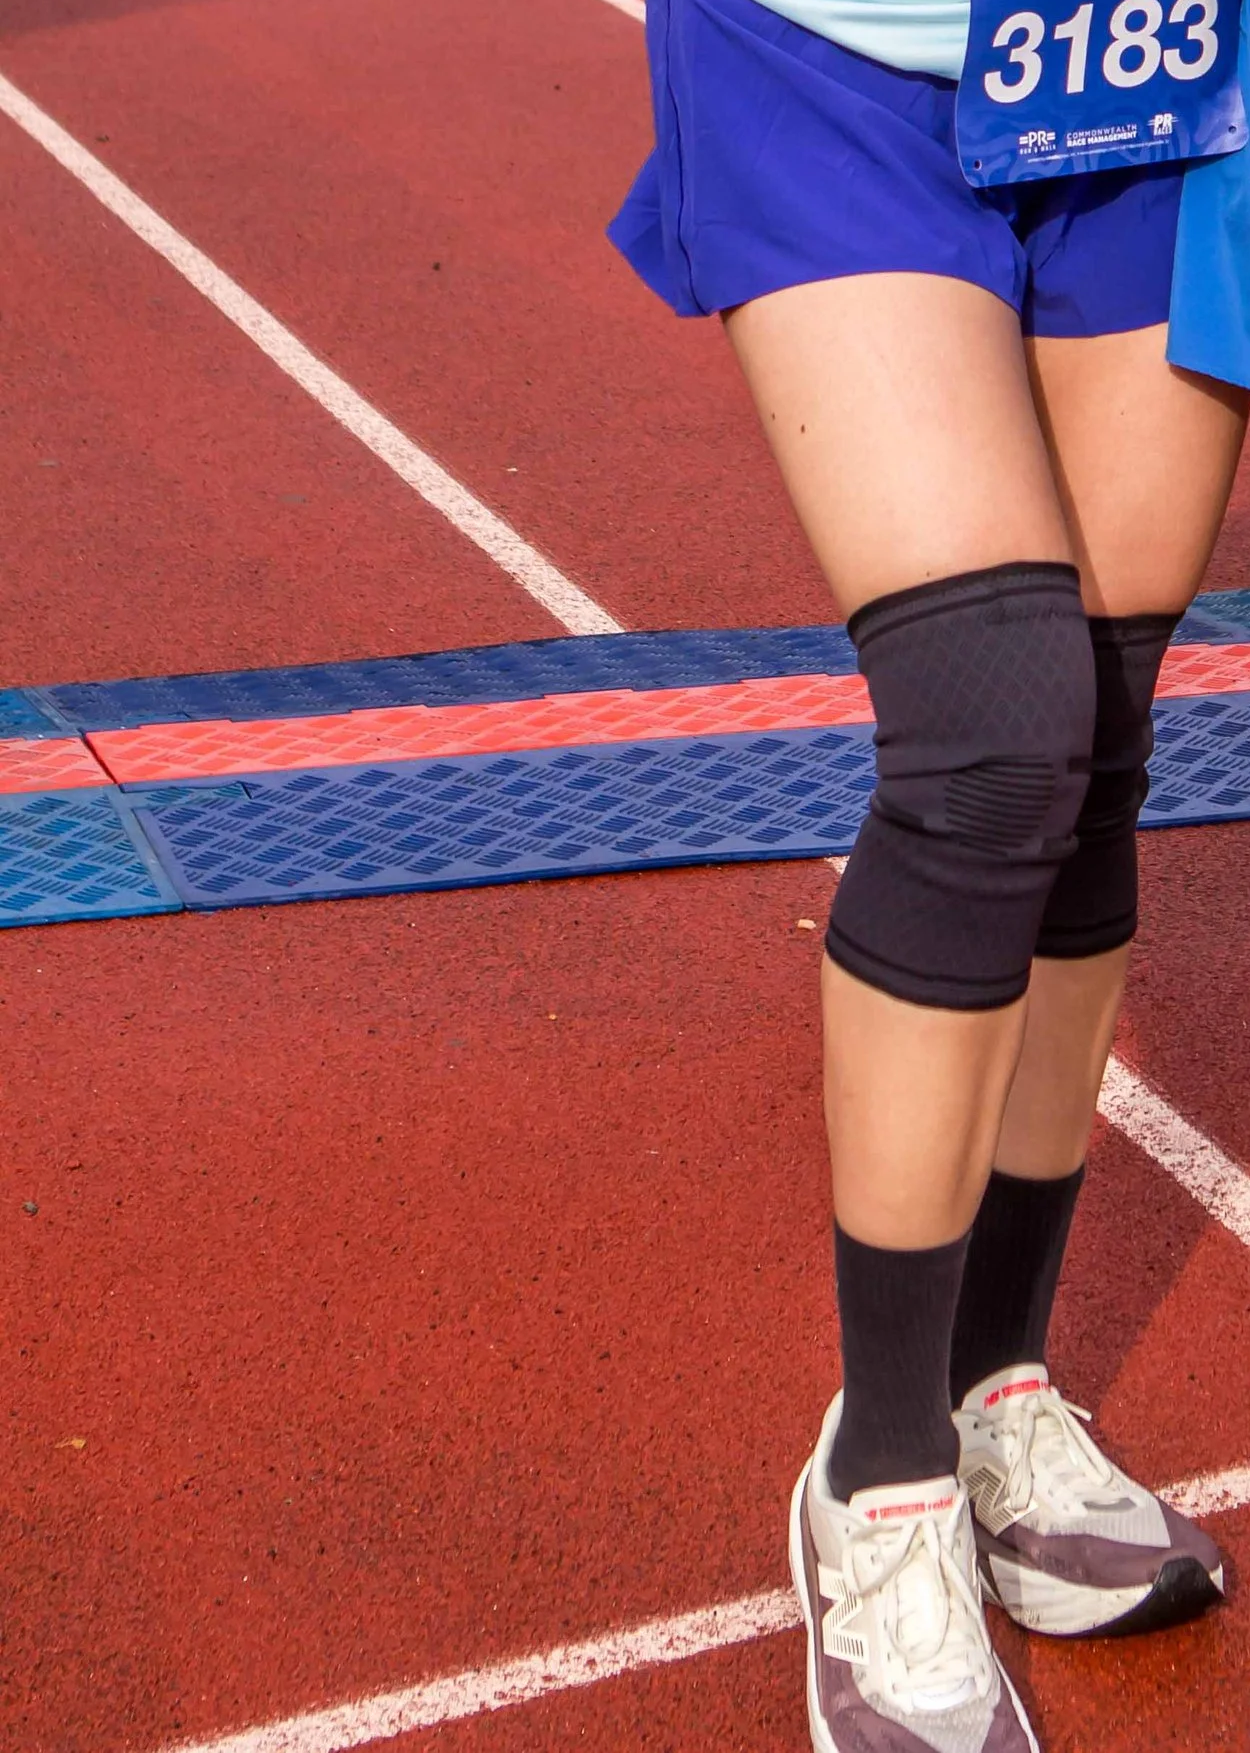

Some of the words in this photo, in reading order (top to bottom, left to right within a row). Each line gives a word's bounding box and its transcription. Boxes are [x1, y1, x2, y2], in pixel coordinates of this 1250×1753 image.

[1066, 124, 1138, 140] COMMONWEALTH
[1066, 138, 1087, 148] RACE
[1087, 130, 1138, 146] MANAGEMENT
